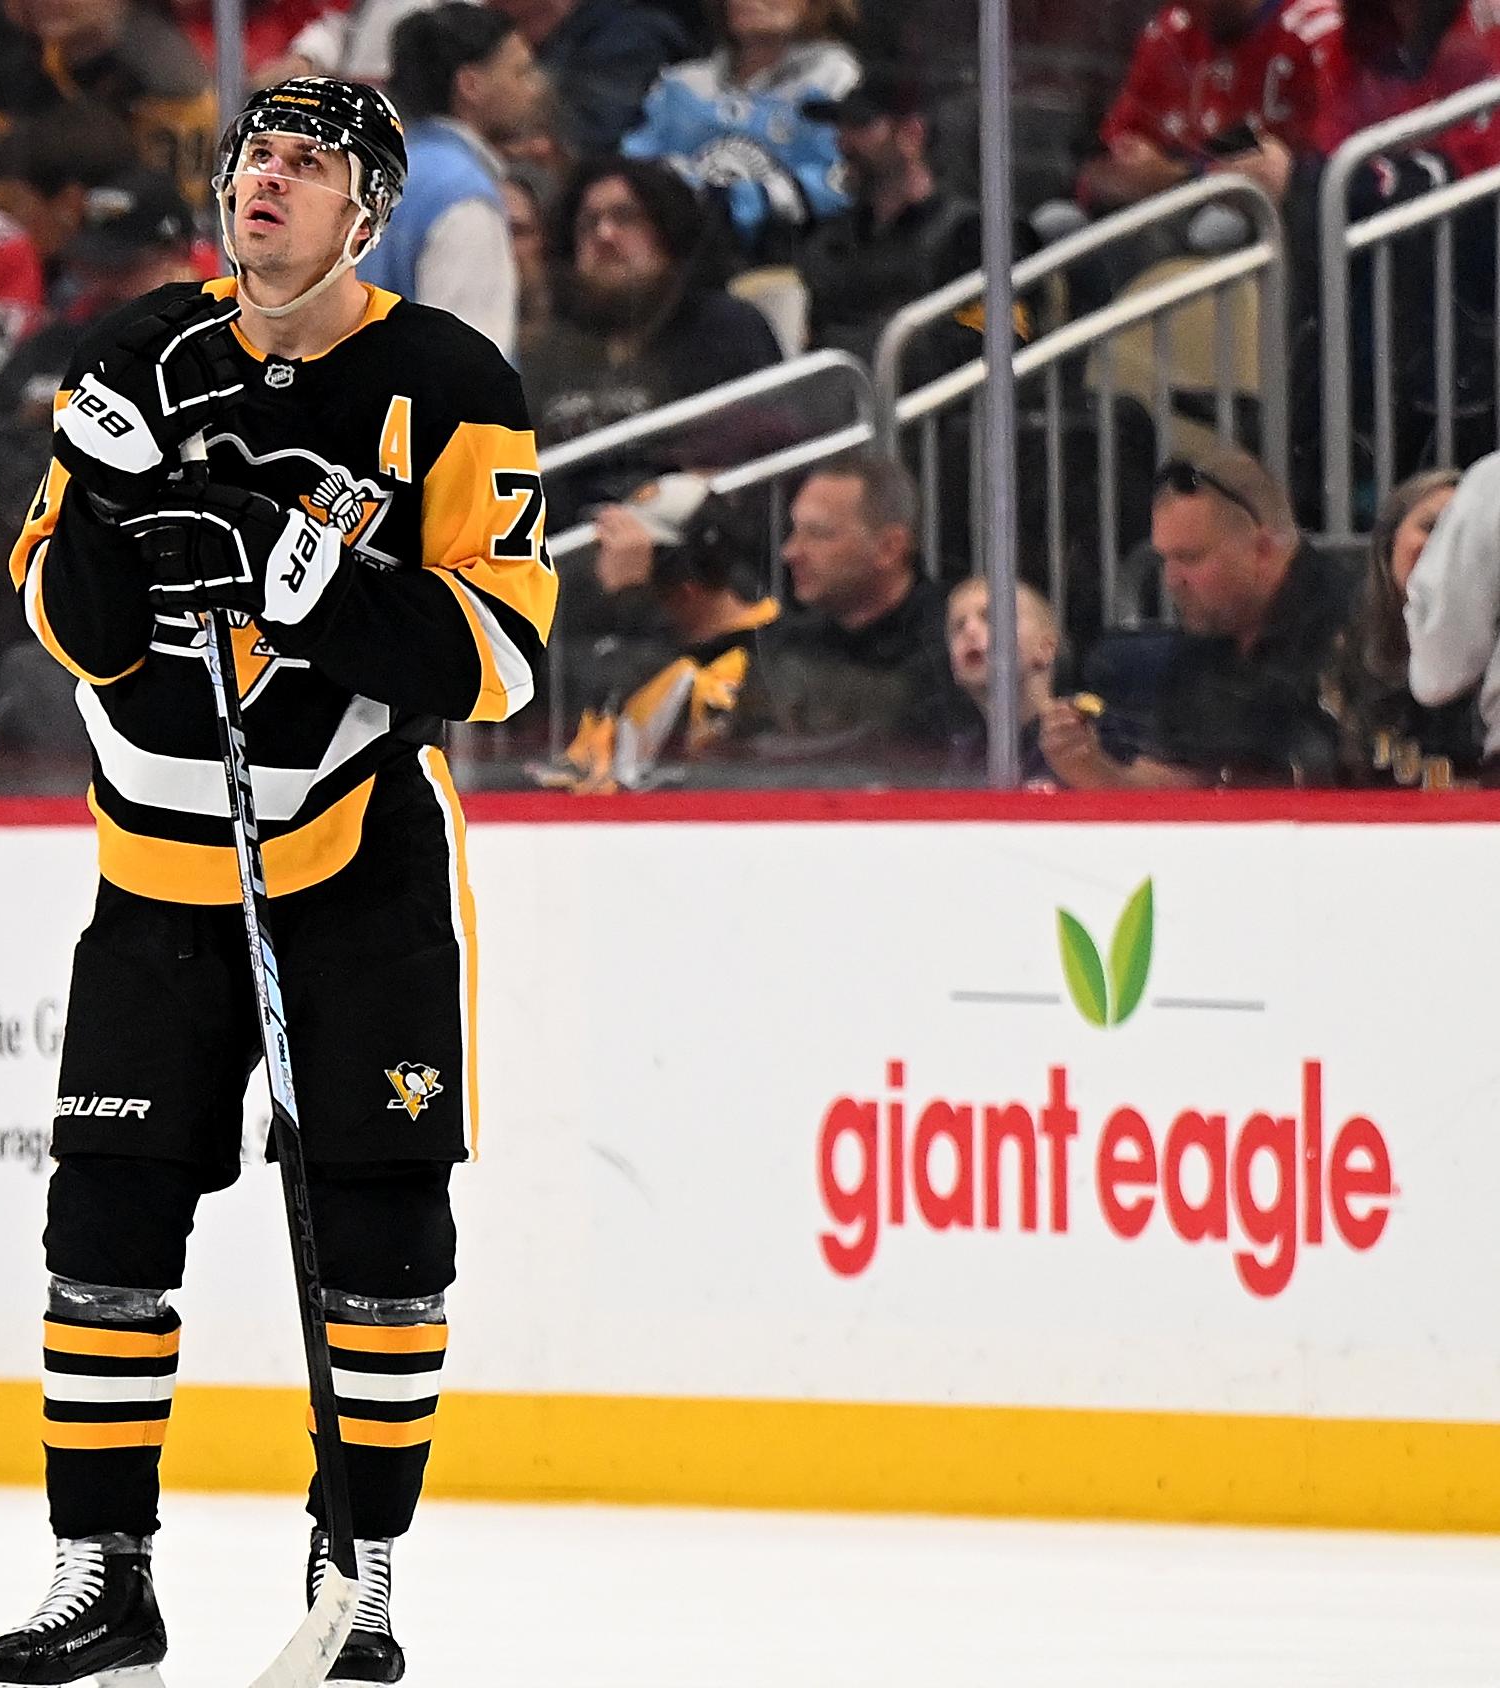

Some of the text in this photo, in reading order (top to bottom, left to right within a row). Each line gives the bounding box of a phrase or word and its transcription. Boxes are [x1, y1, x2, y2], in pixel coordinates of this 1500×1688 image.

[379, 395, 412, 483] A
[276, 1032, 287, 1063] PRO
[816, 1057, 1394, 1298] giant eagle
